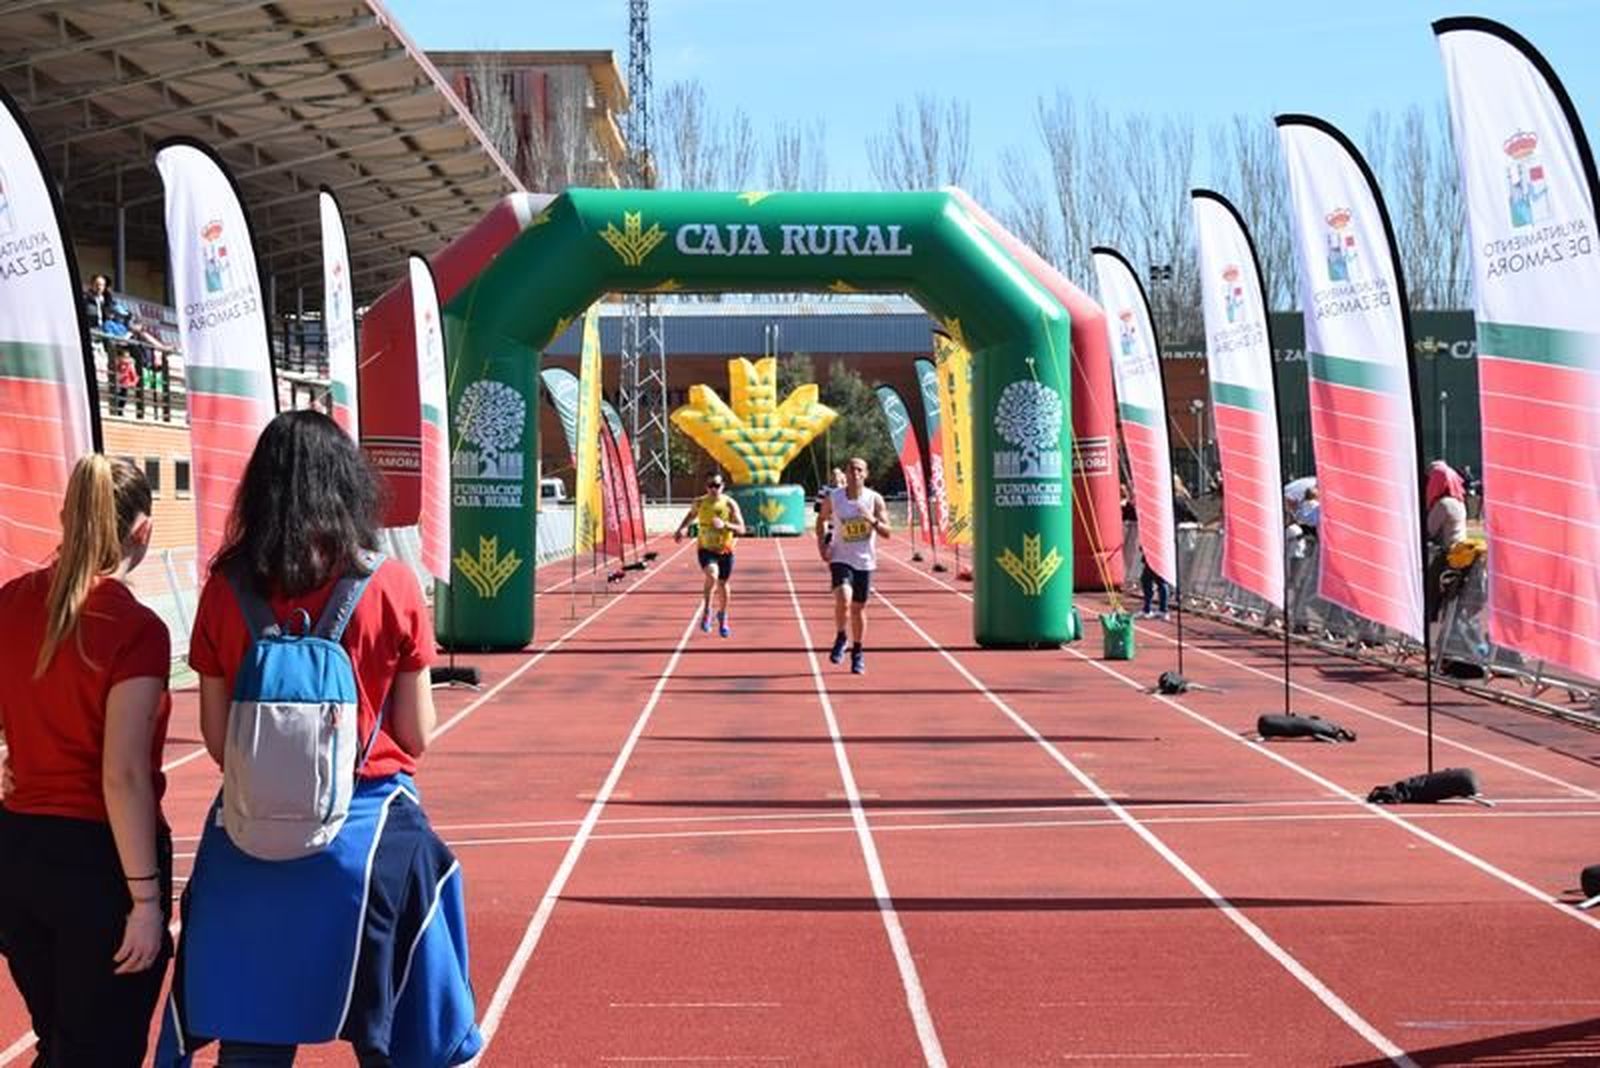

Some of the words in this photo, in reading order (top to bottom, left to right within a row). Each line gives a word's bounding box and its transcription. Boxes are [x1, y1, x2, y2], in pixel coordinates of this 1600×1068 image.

[675, 223, 769, 256] CAJA
[780, 224, 913, 256] RURAL
[453, 494, 482, 508] CAJA
[484, 495, 524, 508] RURAL
[994, 494, 1025, 508] CAJA
[1026, 494, 1063, 507] RURAL
